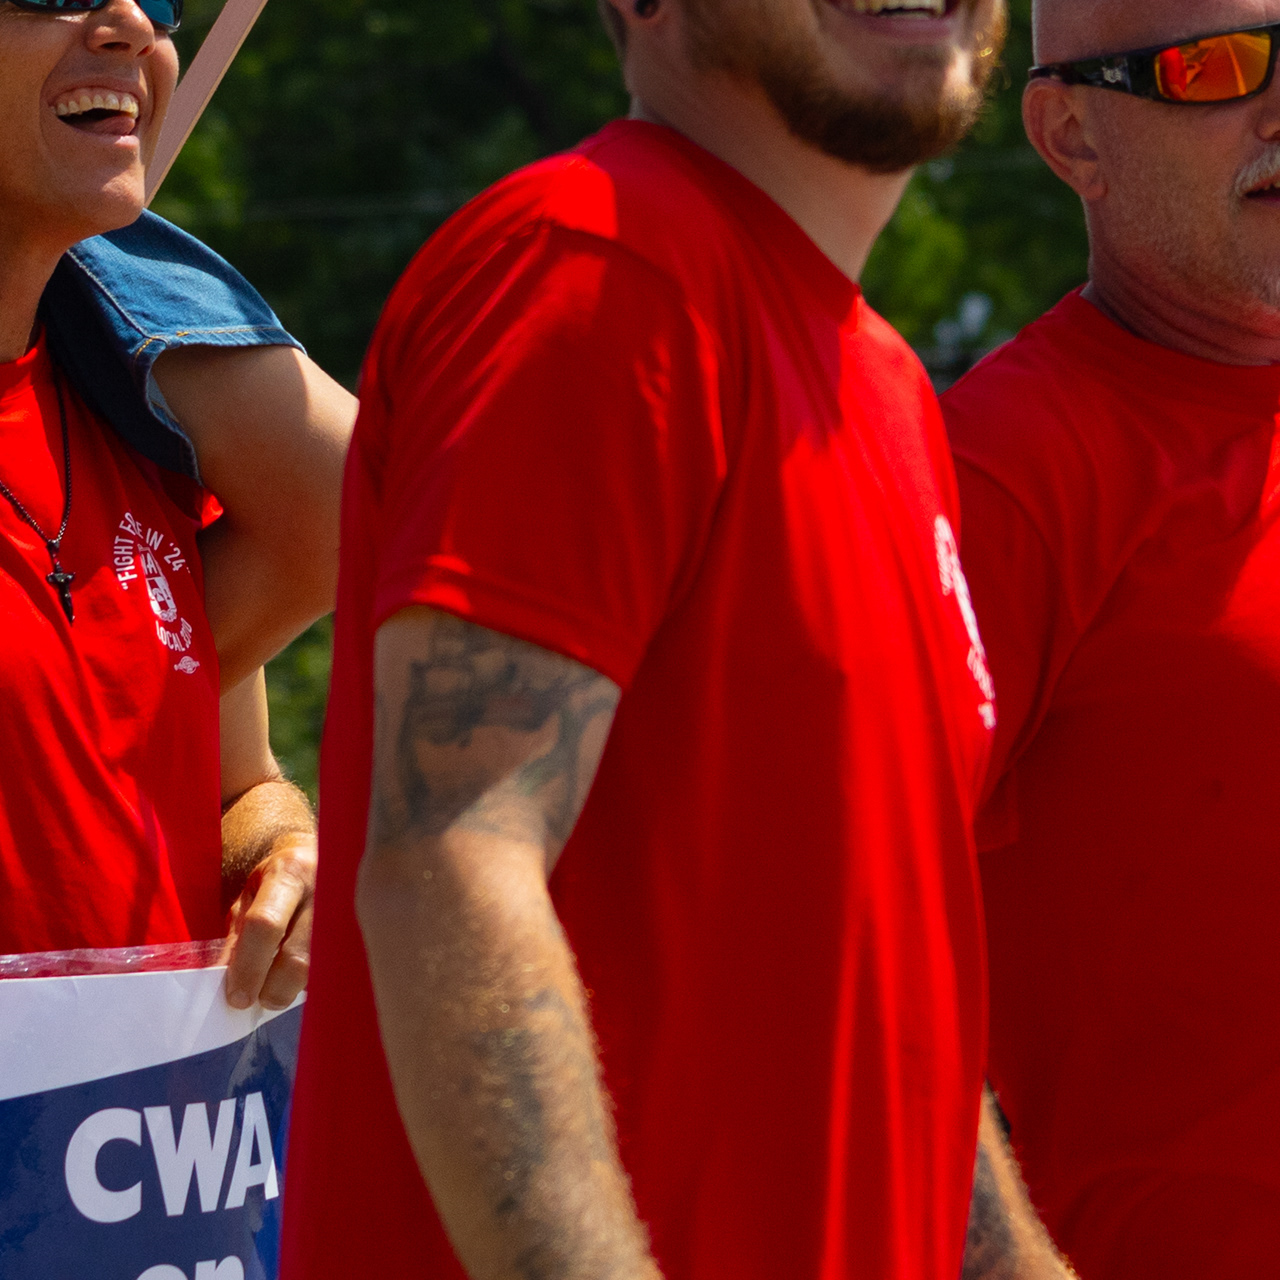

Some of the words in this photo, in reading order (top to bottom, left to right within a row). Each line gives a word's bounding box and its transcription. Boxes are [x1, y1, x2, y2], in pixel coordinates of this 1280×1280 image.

[146, 528, 164, 551] IN
[155, 620, 185, 652] LOCAL
[65, 1091, 279, 1223] CWA
